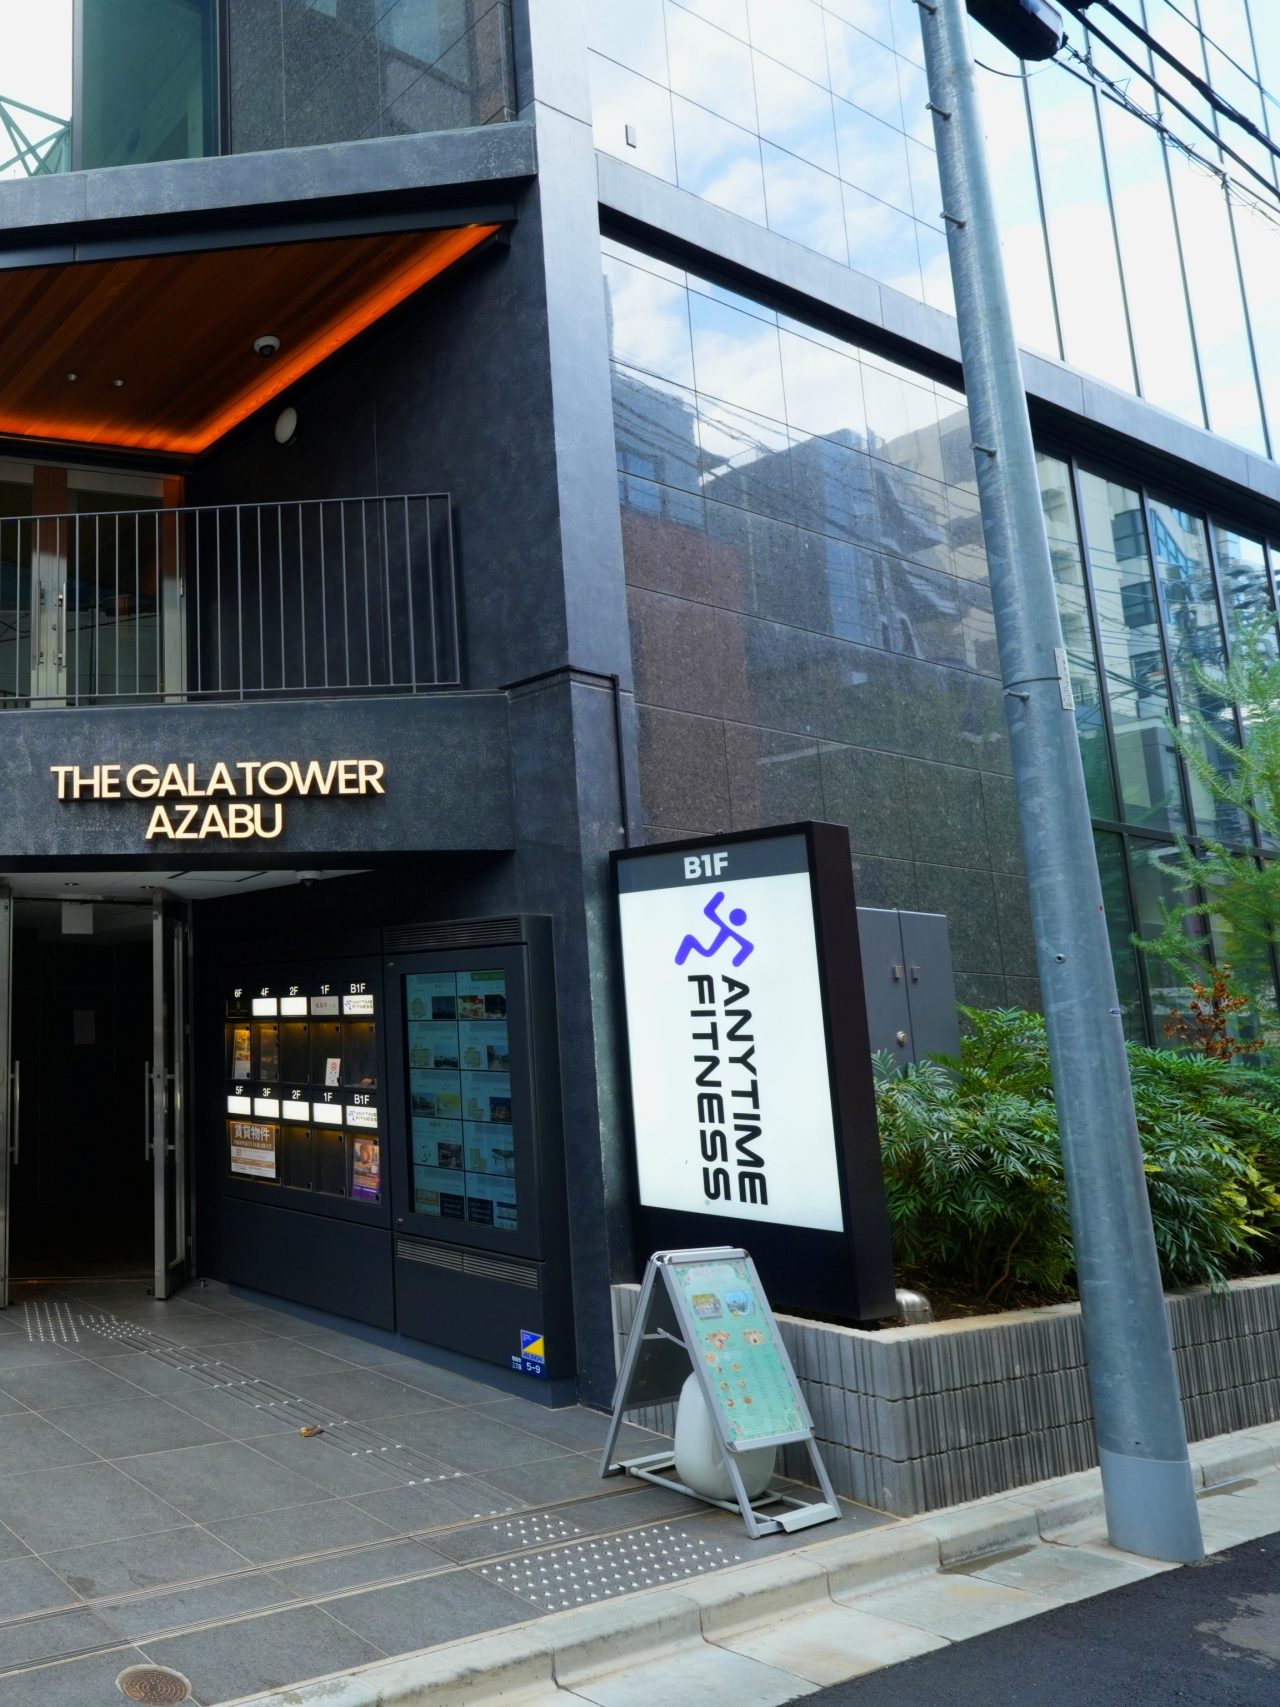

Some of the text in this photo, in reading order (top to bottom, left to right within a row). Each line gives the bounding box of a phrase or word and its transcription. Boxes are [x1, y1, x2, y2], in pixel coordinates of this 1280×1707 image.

[50, 759, 385, 799] THE GALA TOWER
[145, 803, 284, 840] AZABU
[683, 852, 729, 880] B1F
[234, 988, 242, 998] 6F
[260, 987, 269, 997] 4F
[289, 986, 299, 996] 2F
[320, 984, 330, 995] 1F
[350, 983, 366, 994] B1F
[235, 1086, 244, 1095] 5F
[262, 1087, 271, 1097] 3F
[687, 974, 732, 1202] FITNESS
[721, 974, 769, 1206] ANYTIME
[292, 1090, 301, 1100] 2F
[323, 1092, 333, 1102] 1F
[354, 1094, 370, 1105] B1F
[526, 1361, 541, 1374] 5-9
